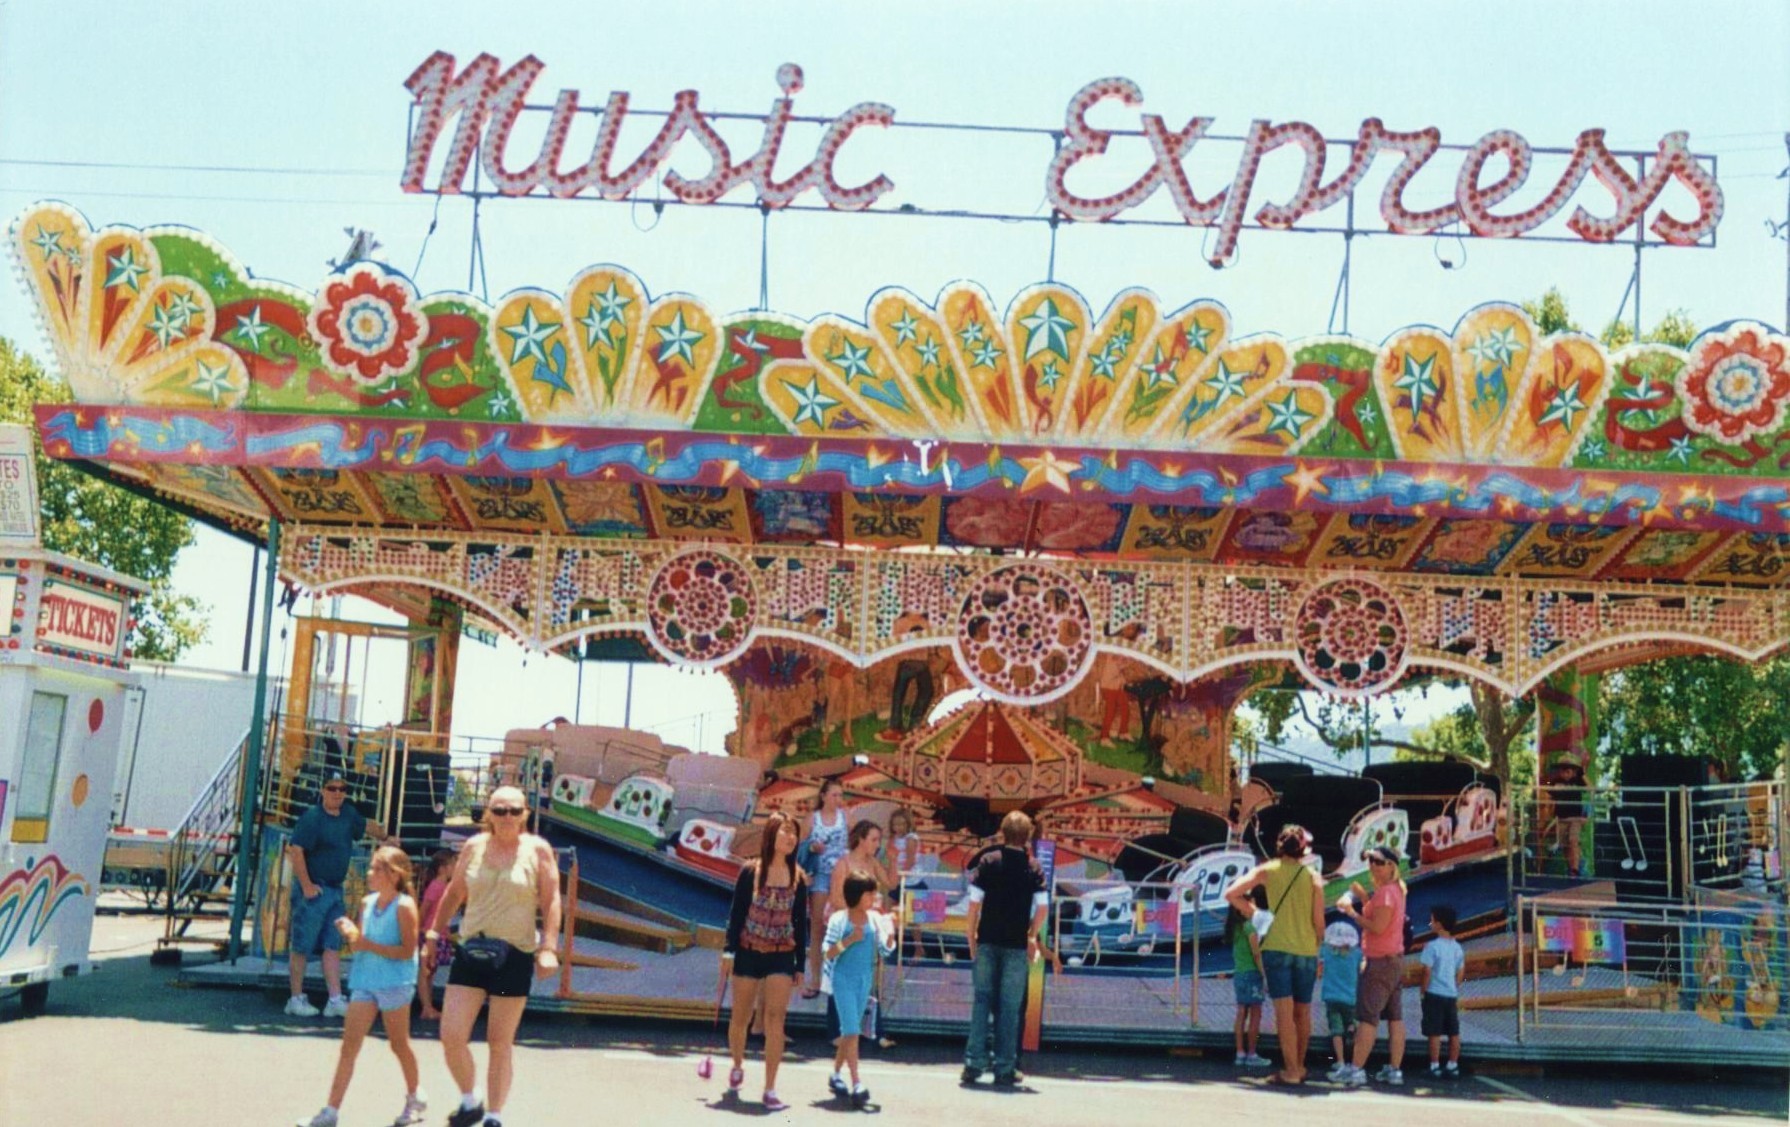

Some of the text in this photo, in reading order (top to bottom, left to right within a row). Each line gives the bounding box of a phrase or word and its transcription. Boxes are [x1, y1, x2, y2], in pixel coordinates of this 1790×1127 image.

[400, 49, 1724, 268] Music Express
[43, 594, 117, 646] TICKETS
